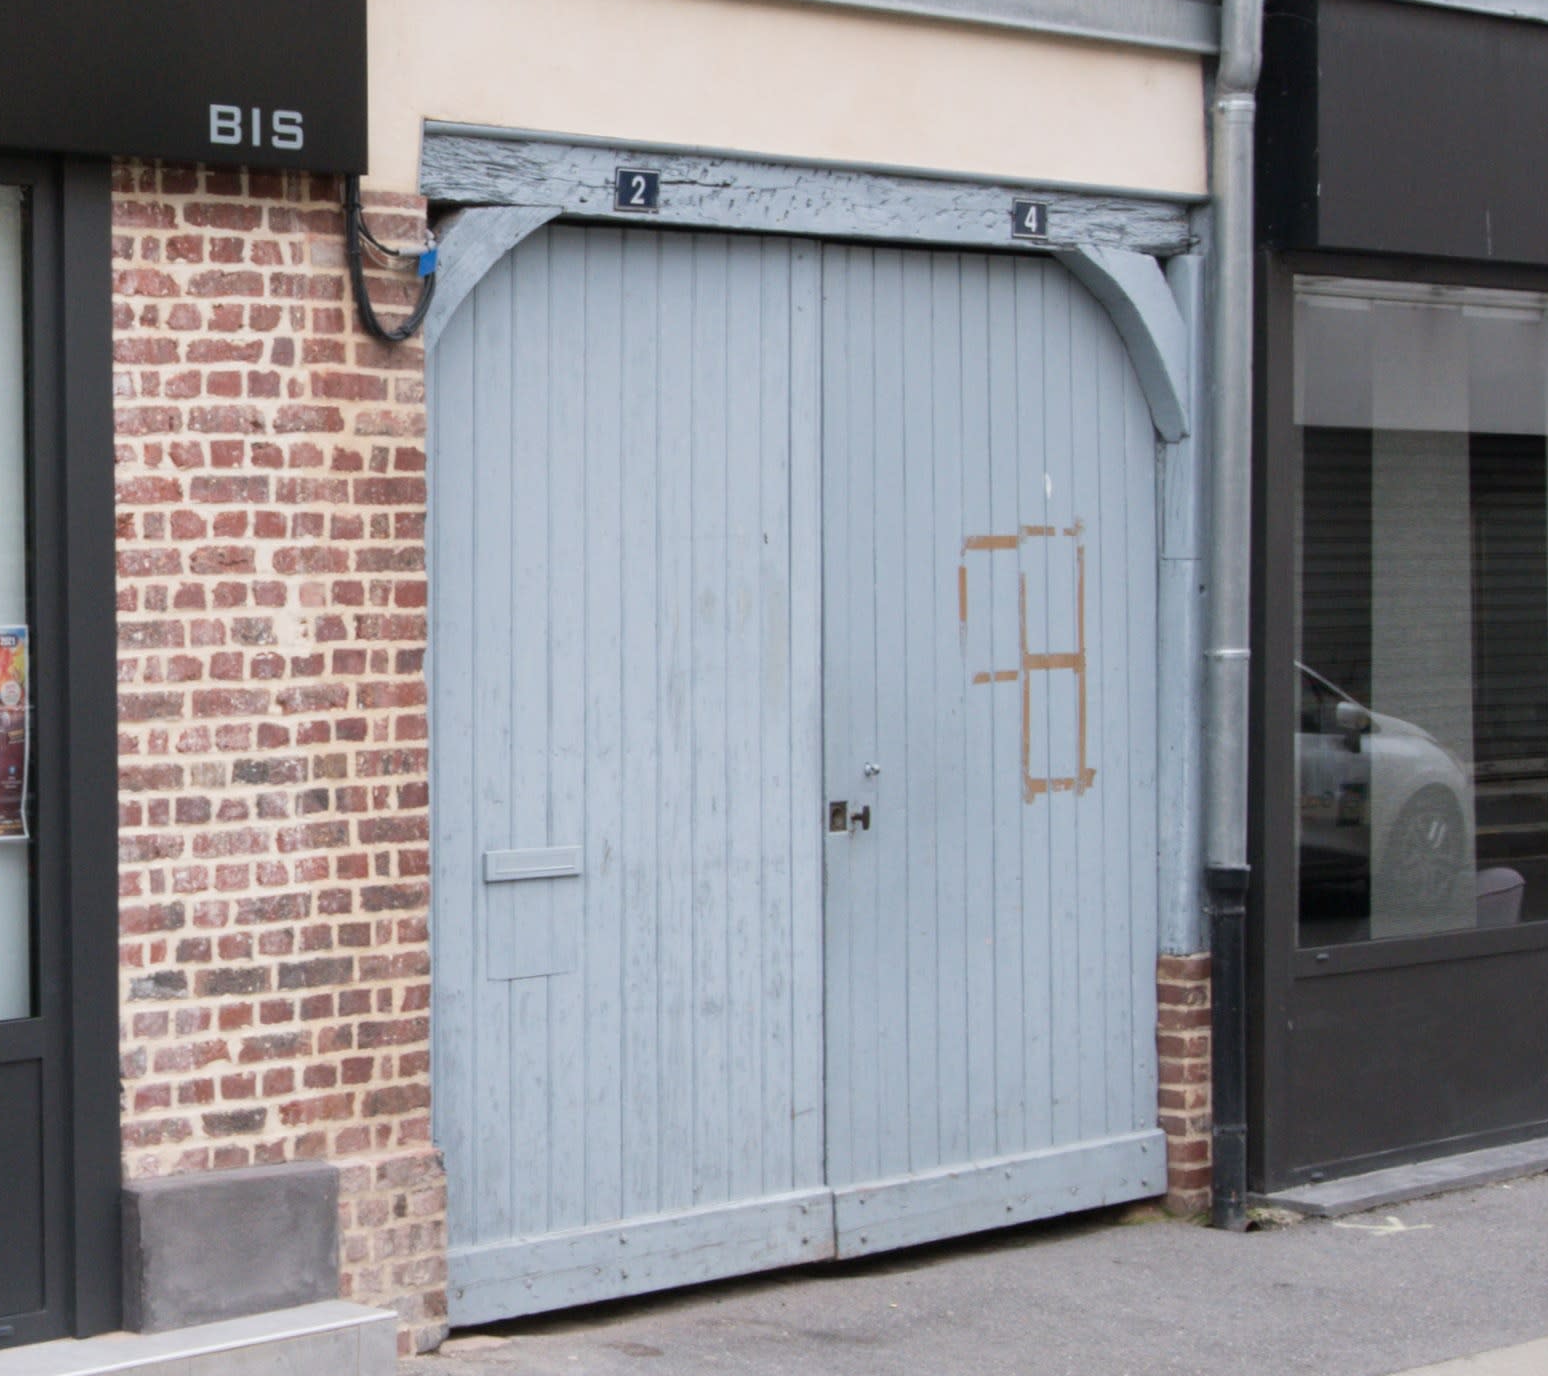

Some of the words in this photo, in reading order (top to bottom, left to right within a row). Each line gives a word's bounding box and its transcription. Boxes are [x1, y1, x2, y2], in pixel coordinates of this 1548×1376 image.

[209, 104, 304, 150] BIS
[630, 175, 646, 205] 2
[1024, 205, 1037, 233] 4
